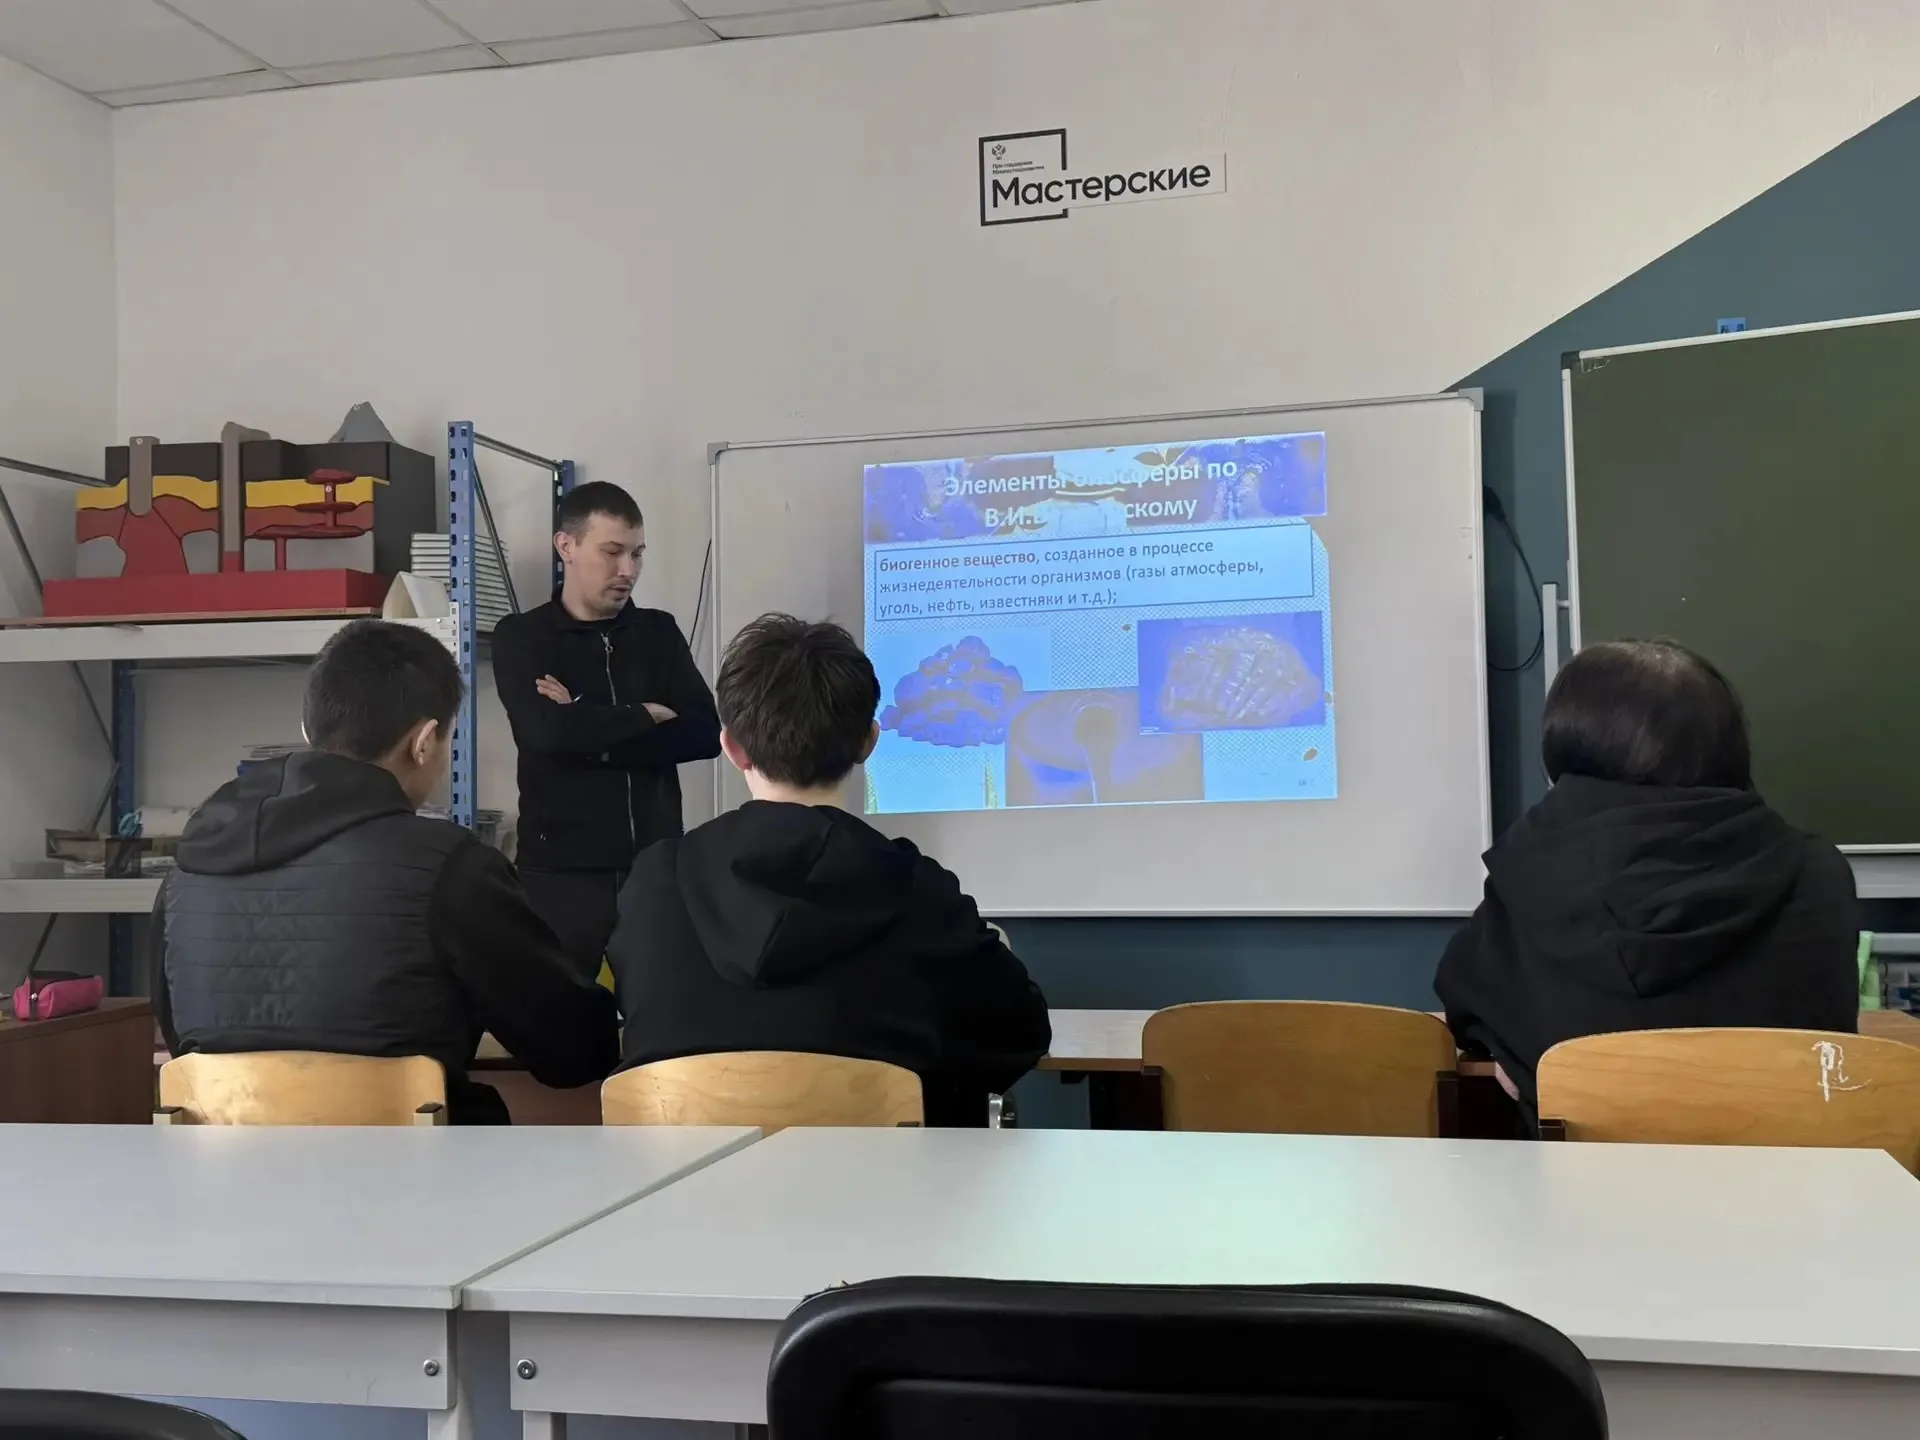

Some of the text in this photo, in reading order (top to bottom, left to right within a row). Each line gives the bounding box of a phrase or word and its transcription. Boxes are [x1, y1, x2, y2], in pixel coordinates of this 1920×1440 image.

[992, 164, 1211, 208] Мастерские
[943, 474, 1067, 496] Элементы
[1208, 461, 1237, 479] по
[880, 541, 1214, 572] биогенное вещество, созданное в процессе
[880, 559, 1264, 593] жизнедеятельности организмов (газы атмосферы,
[880, 588, 1117, 618] уголь, нефть, известняки и т.д.);
